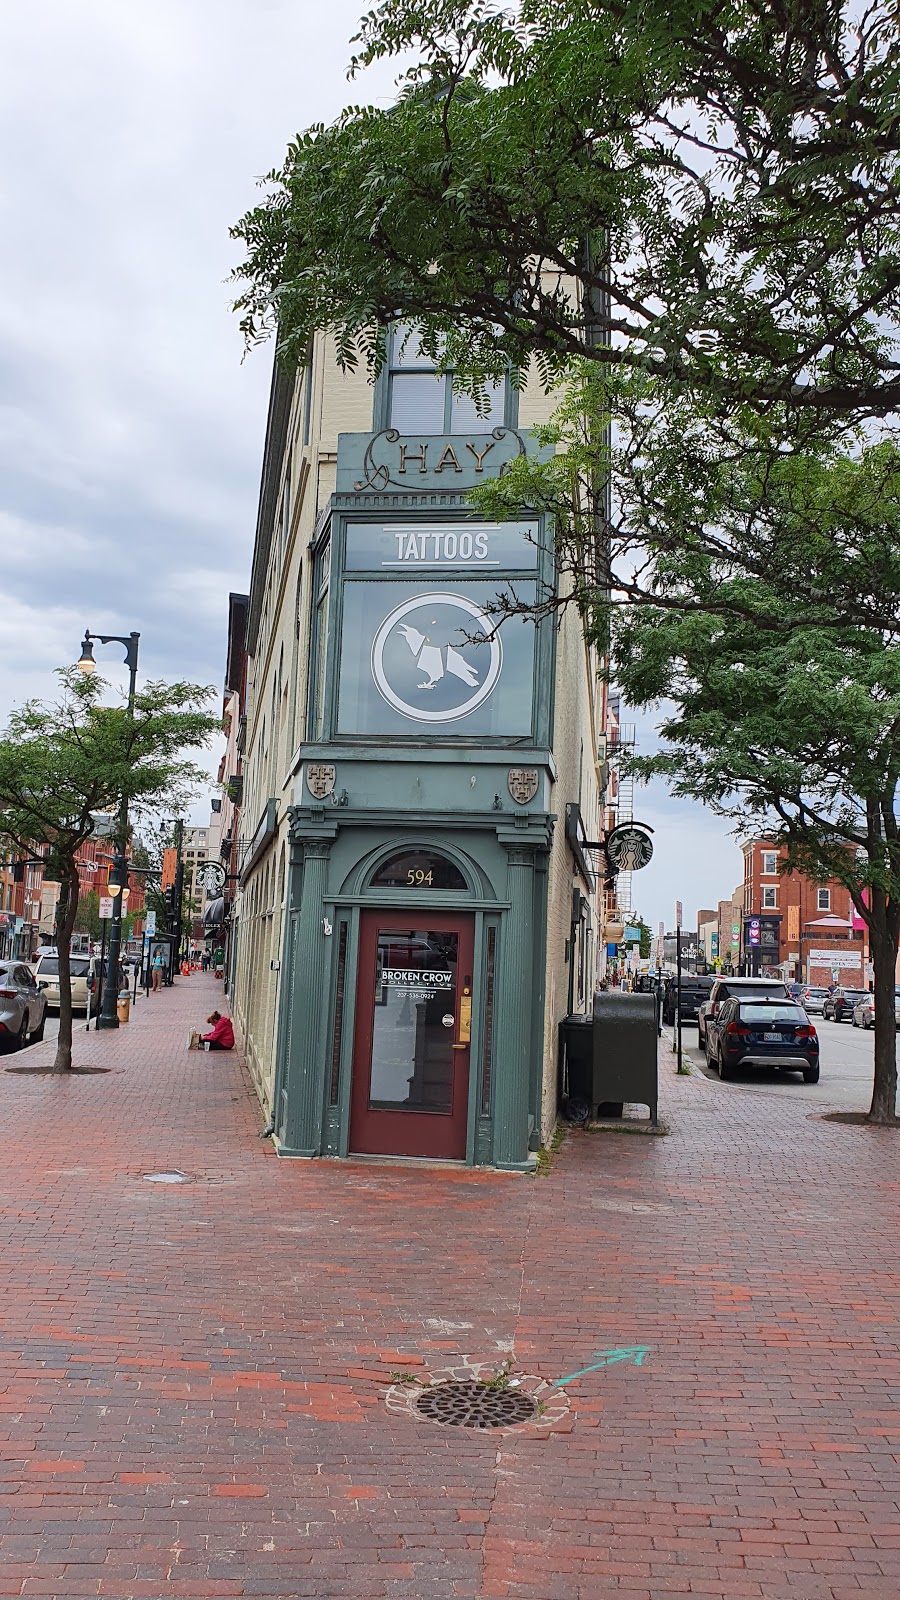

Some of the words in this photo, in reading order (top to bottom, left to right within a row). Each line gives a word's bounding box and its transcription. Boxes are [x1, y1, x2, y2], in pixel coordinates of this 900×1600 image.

[398, 442, 495, 473] HAY
[394, 532, 489, 561] TATTOOS
[406, 869, 434, 886] 594
[382, 971, 420, 981] BROKEN
[422, 972, 452, 983] CROW
